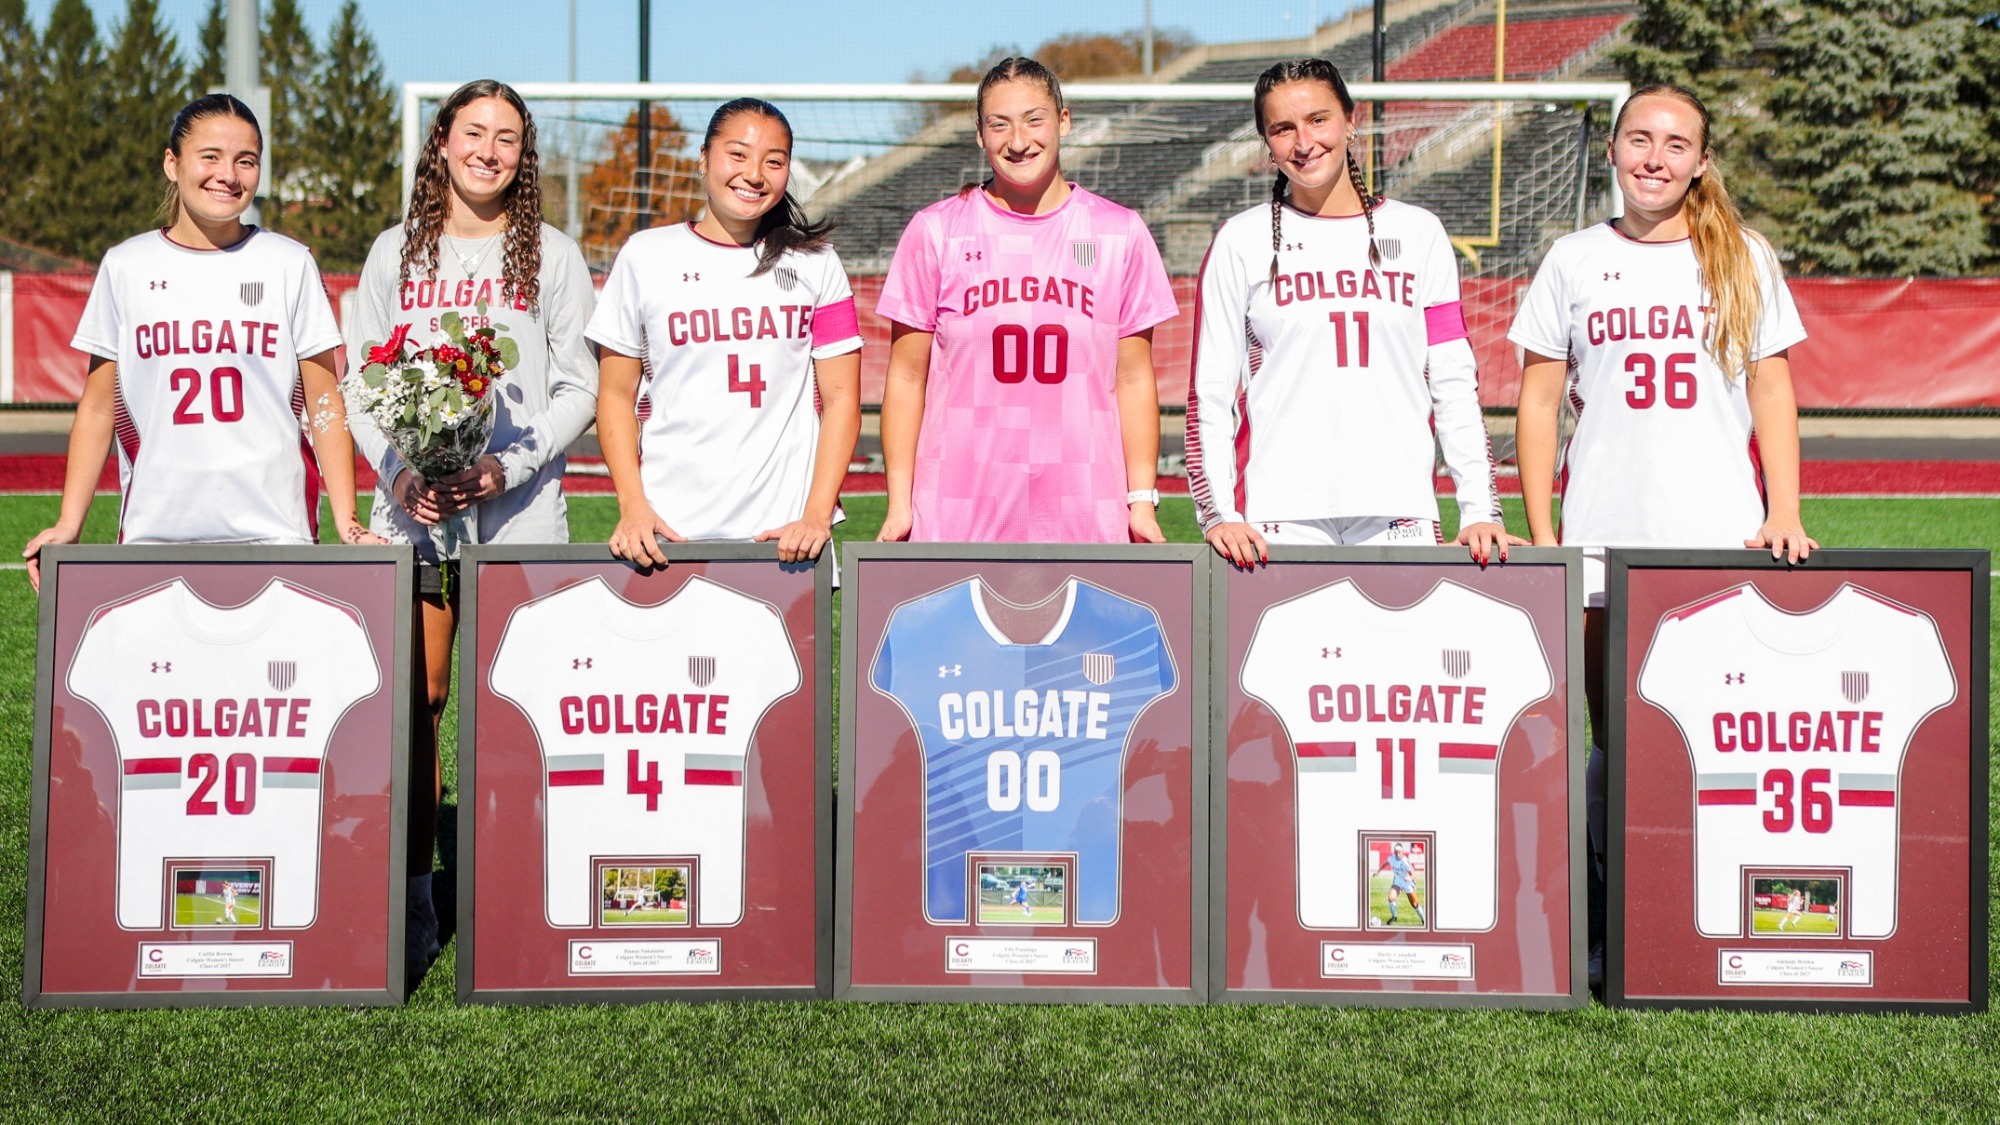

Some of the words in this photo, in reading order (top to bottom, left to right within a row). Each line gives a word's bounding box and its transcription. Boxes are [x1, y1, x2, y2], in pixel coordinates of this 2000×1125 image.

[963, 277, 1093, 319] COLGATE
[1275, 269, 1415, 308] COLGATE
[136, 320, 278, 360] COLGATE
[669, 305, 812, 347] COLGATE
[1329, 311, 1369, 368] 11
[727, 354, 767, 409] 4
[992, 323, 1069, 385] 00
[1625, 353, 1697, 409] 36
[170, 367, 244, 425] 20
[138, 699, 310, 739] COLGATE
[560, 694, 729, 736] COLGATE
[939, 690, 1110, 741] COLGATE
[1310, 685, 1486, 725] COLGATE
[1713, 711, 1884, 753] COLGATE
[186, 753, 256, 816] 20
[627, 749, 663, 812] 4
[987, 751, 1060, 812] 00
[1376, 738, 1416, 800] 11
[1763, 768, 1833, 834] 36
